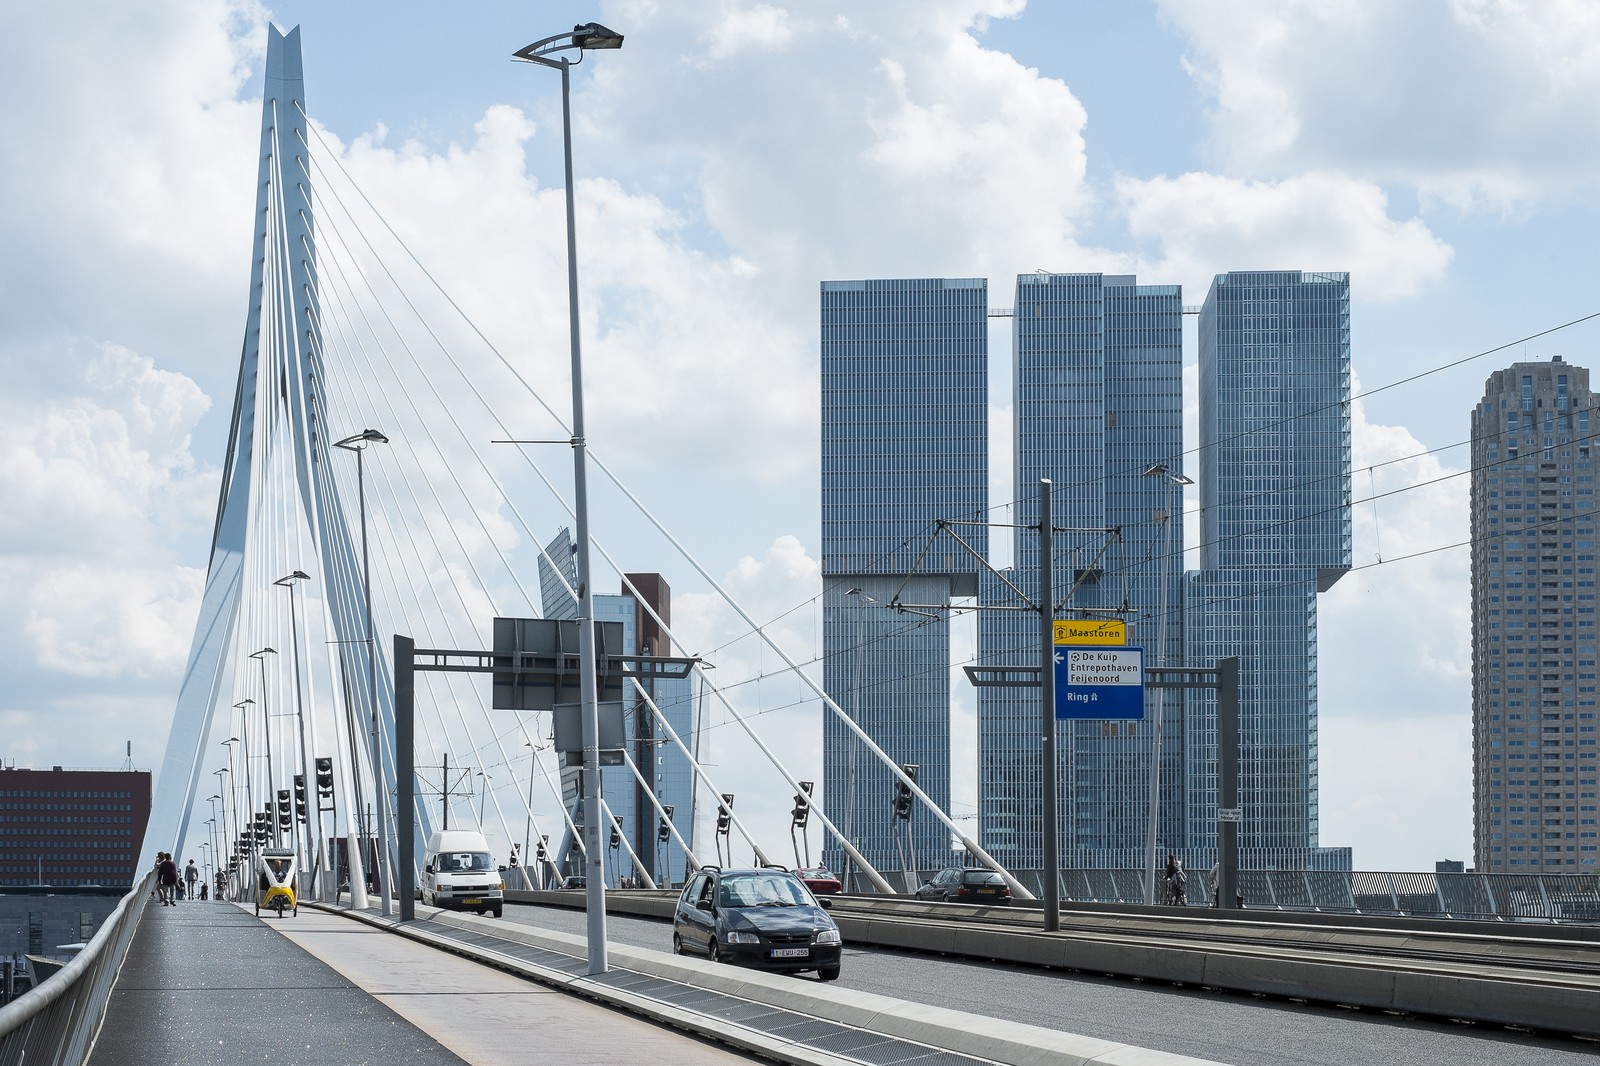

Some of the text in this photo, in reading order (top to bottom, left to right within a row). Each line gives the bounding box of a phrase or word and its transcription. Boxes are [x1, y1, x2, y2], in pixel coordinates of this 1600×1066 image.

[1069, 628, 1120, 638] Maastoren
[1097, 653, 1118, 662] Kuip
[1070, 664, 1138, 673] Entrepothaven
[1070, 674, 1120, 684] Feijenoord
[1067, 692, 1089, 703] Ring
